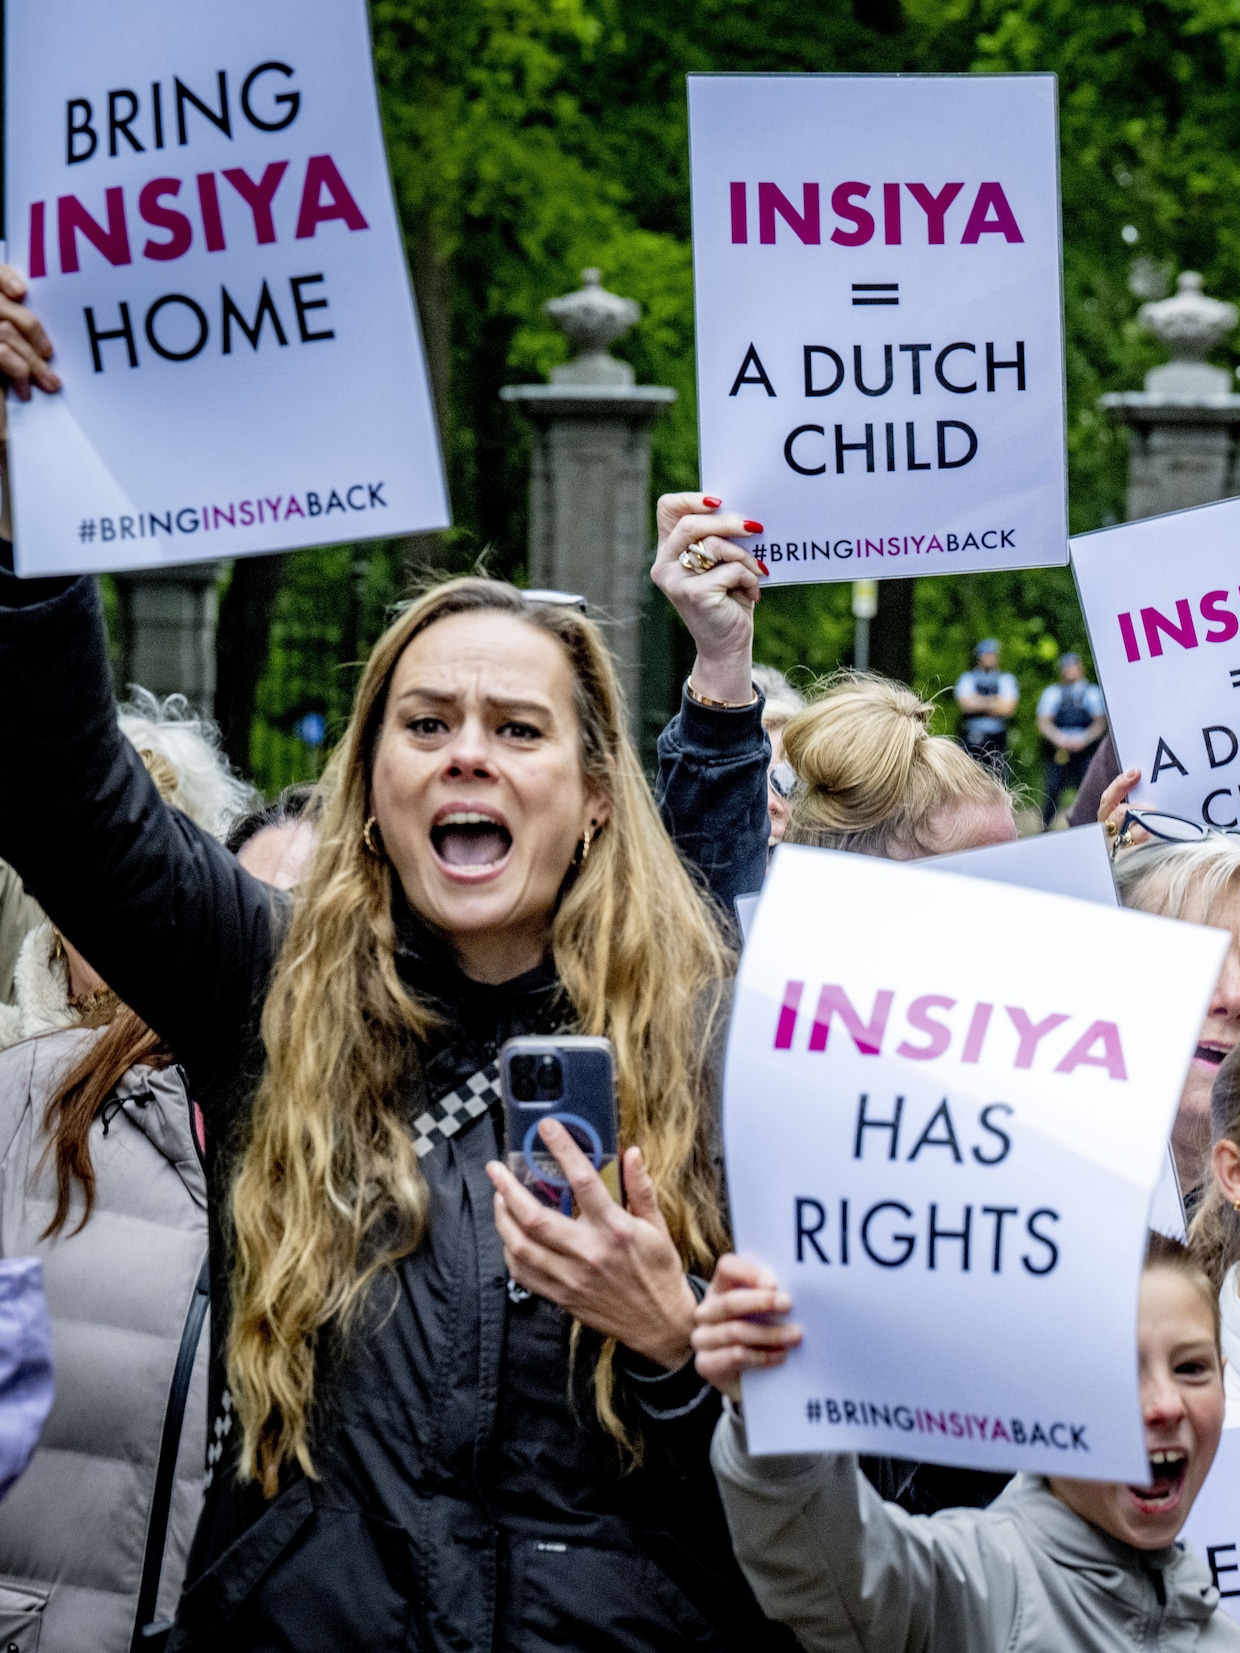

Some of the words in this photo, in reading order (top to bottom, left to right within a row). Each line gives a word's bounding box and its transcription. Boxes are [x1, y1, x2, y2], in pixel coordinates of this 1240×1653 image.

[66, 61, 301, 165] BRING
[29, 154, 370, 279] INSIYA
[729, 180, 1025, 247] INSIYA
[83, 273, 335, 373] HOME
[728, 341, 778, 398] A
[803, 340, 1027, 398] DUTCH
[783, 419, 979, 476] CHILD
[78, 481, 388, 543] #BRINGINSIYABACK
[753, 528, 1017, 563] #BRINGINSIYABACK
[1150, 736, 1190, 784] A
[773, 980, 1129, 1082] INSIYA
[852, 1093, 1016, 1167] HAS
[793, 1196, 1062, 1278] RIGHTS
[806, 1397, 1091, 1453] #BRINGINSIYABACK
